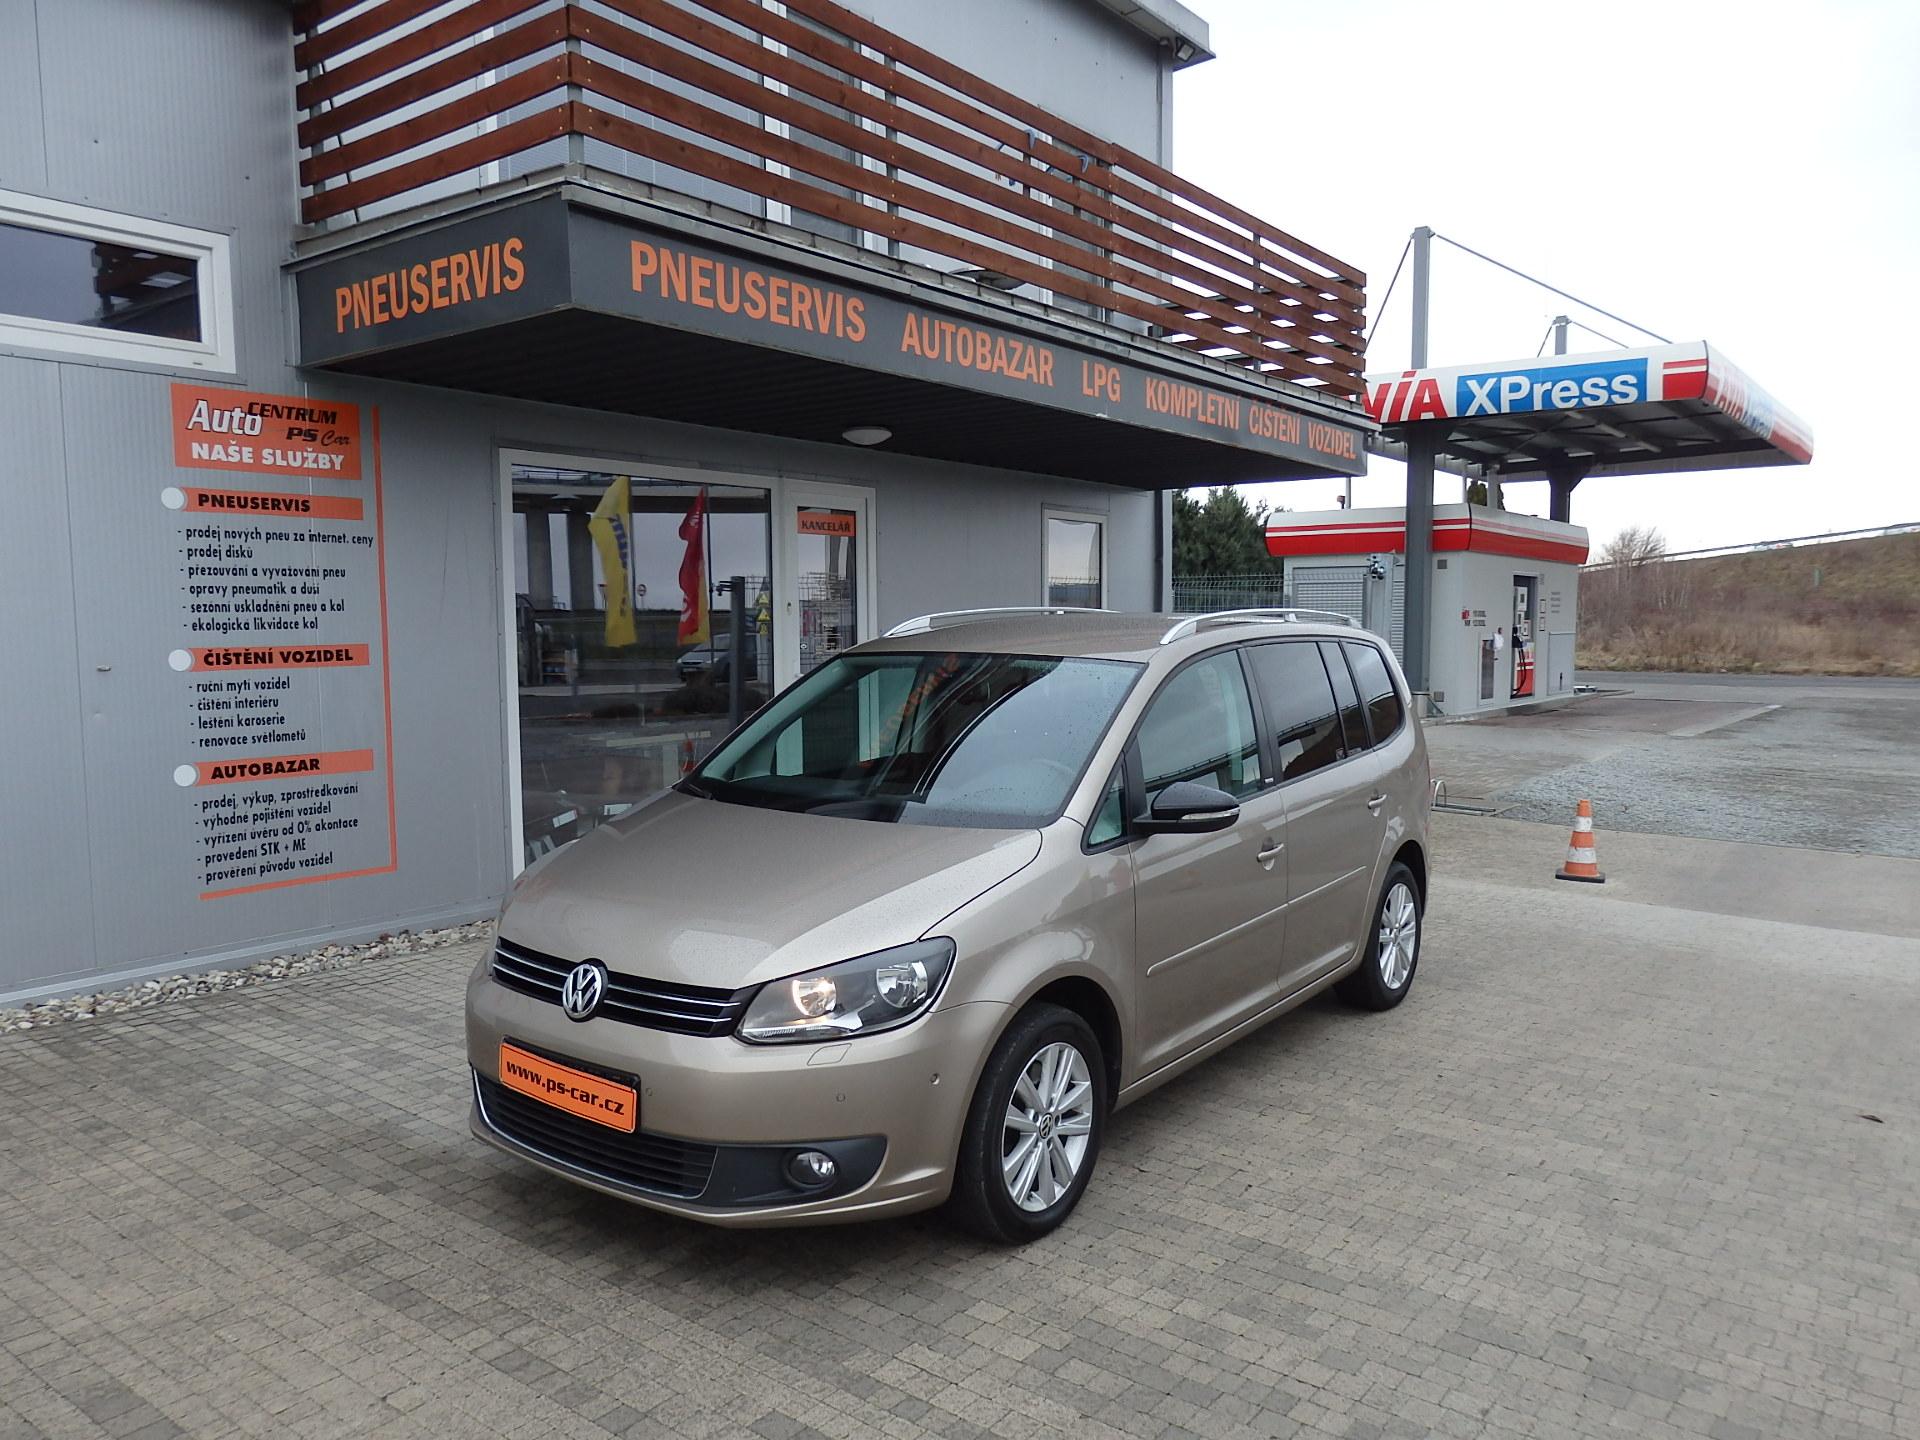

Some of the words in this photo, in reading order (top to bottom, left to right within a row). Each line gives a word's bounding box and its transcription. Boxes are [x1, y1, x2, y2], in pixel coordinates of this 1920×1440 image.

[335, 237, 525, 333] PNEUSERVIS
[630, 240, 866, 343] PNEUSERVIS
[901, 312, 1055, 386] AUTOBAZAR
[1082, 360, 1122, 403] LPG
[1307, 421, 1357, 460] VOZIDEL
[1464, 373, 1640, 416] XPress
[185, 398, 264, 436] Auto
[247, 402, 337, 425] CENTRUM
[286, 426, 319, 442] PS
[321, 429, 351, 447] Car
[191, 439, 254, 464] NAŠE
[262, 447, 345, 471] SLUŽBY
[198, 493, 311, 513] PNEUSERVIS
[186, 525, 221, 543] prodej
[224, 527, 262, 543] nových
[265, 531, 290, 544] pneu
[293, 532, 305, 542] za
[308, 529, 349, 544] internet.
[352, 535, 374, 548] ceny
[187, 544, 222, 561] prodej
[188, 565, 248, 582] přezouvání
[251, 568, 258, 578] a
[323, 567, 346, 580] pneu
[190, 585, 227, 598] opravy
[232, 581, 287, 597] pneumatik
[290, 585, 297, 595] a
[293, 602, 317, 615] pneu
[321, 602, 327, 612] a
[330, 599, 345, 612] kol
[191, 617, 250, 635] ekologická
[253, 617, 300, 631] likvidace
[303, 617, 319, 631] kol
[203, 647, 273, 666] ČIŠTĚNÍ
[280, 648, 354, 663] VOZIDEL
[196, 679, 223, 693] ruční
[254, 676, 291, 691] vozidel
[197, 697, 232, 711] čištění
[235, 694, 279, 710] interiéru
[198, 715, 234, 730] leštění
[237, 711, 286, 728] karoserie
[199, 732, 248, 748] renovace
[251, 728, 306, 745] světlometů
[211, 758, 321, 780] AUTOBAZAR
[203, 810, 249, 830] výhodné
[252, 806, 294, 826] pojištění
[297, 801, 332, 817] vozidel
[282, 823, 294, 837] od
[297, 820, 312, 835] 0%
[315, 817, 359, 833] akontace
[205, 847, 258, 867] provedení
[260, 842, 280, 857] STK
[292, 838, 306, 851] ME
[259, 861, 296, 877] původu
[299, 851, 333, 868] vozidel
[505, 1058, 626, 1115] www.ps-car.cz
